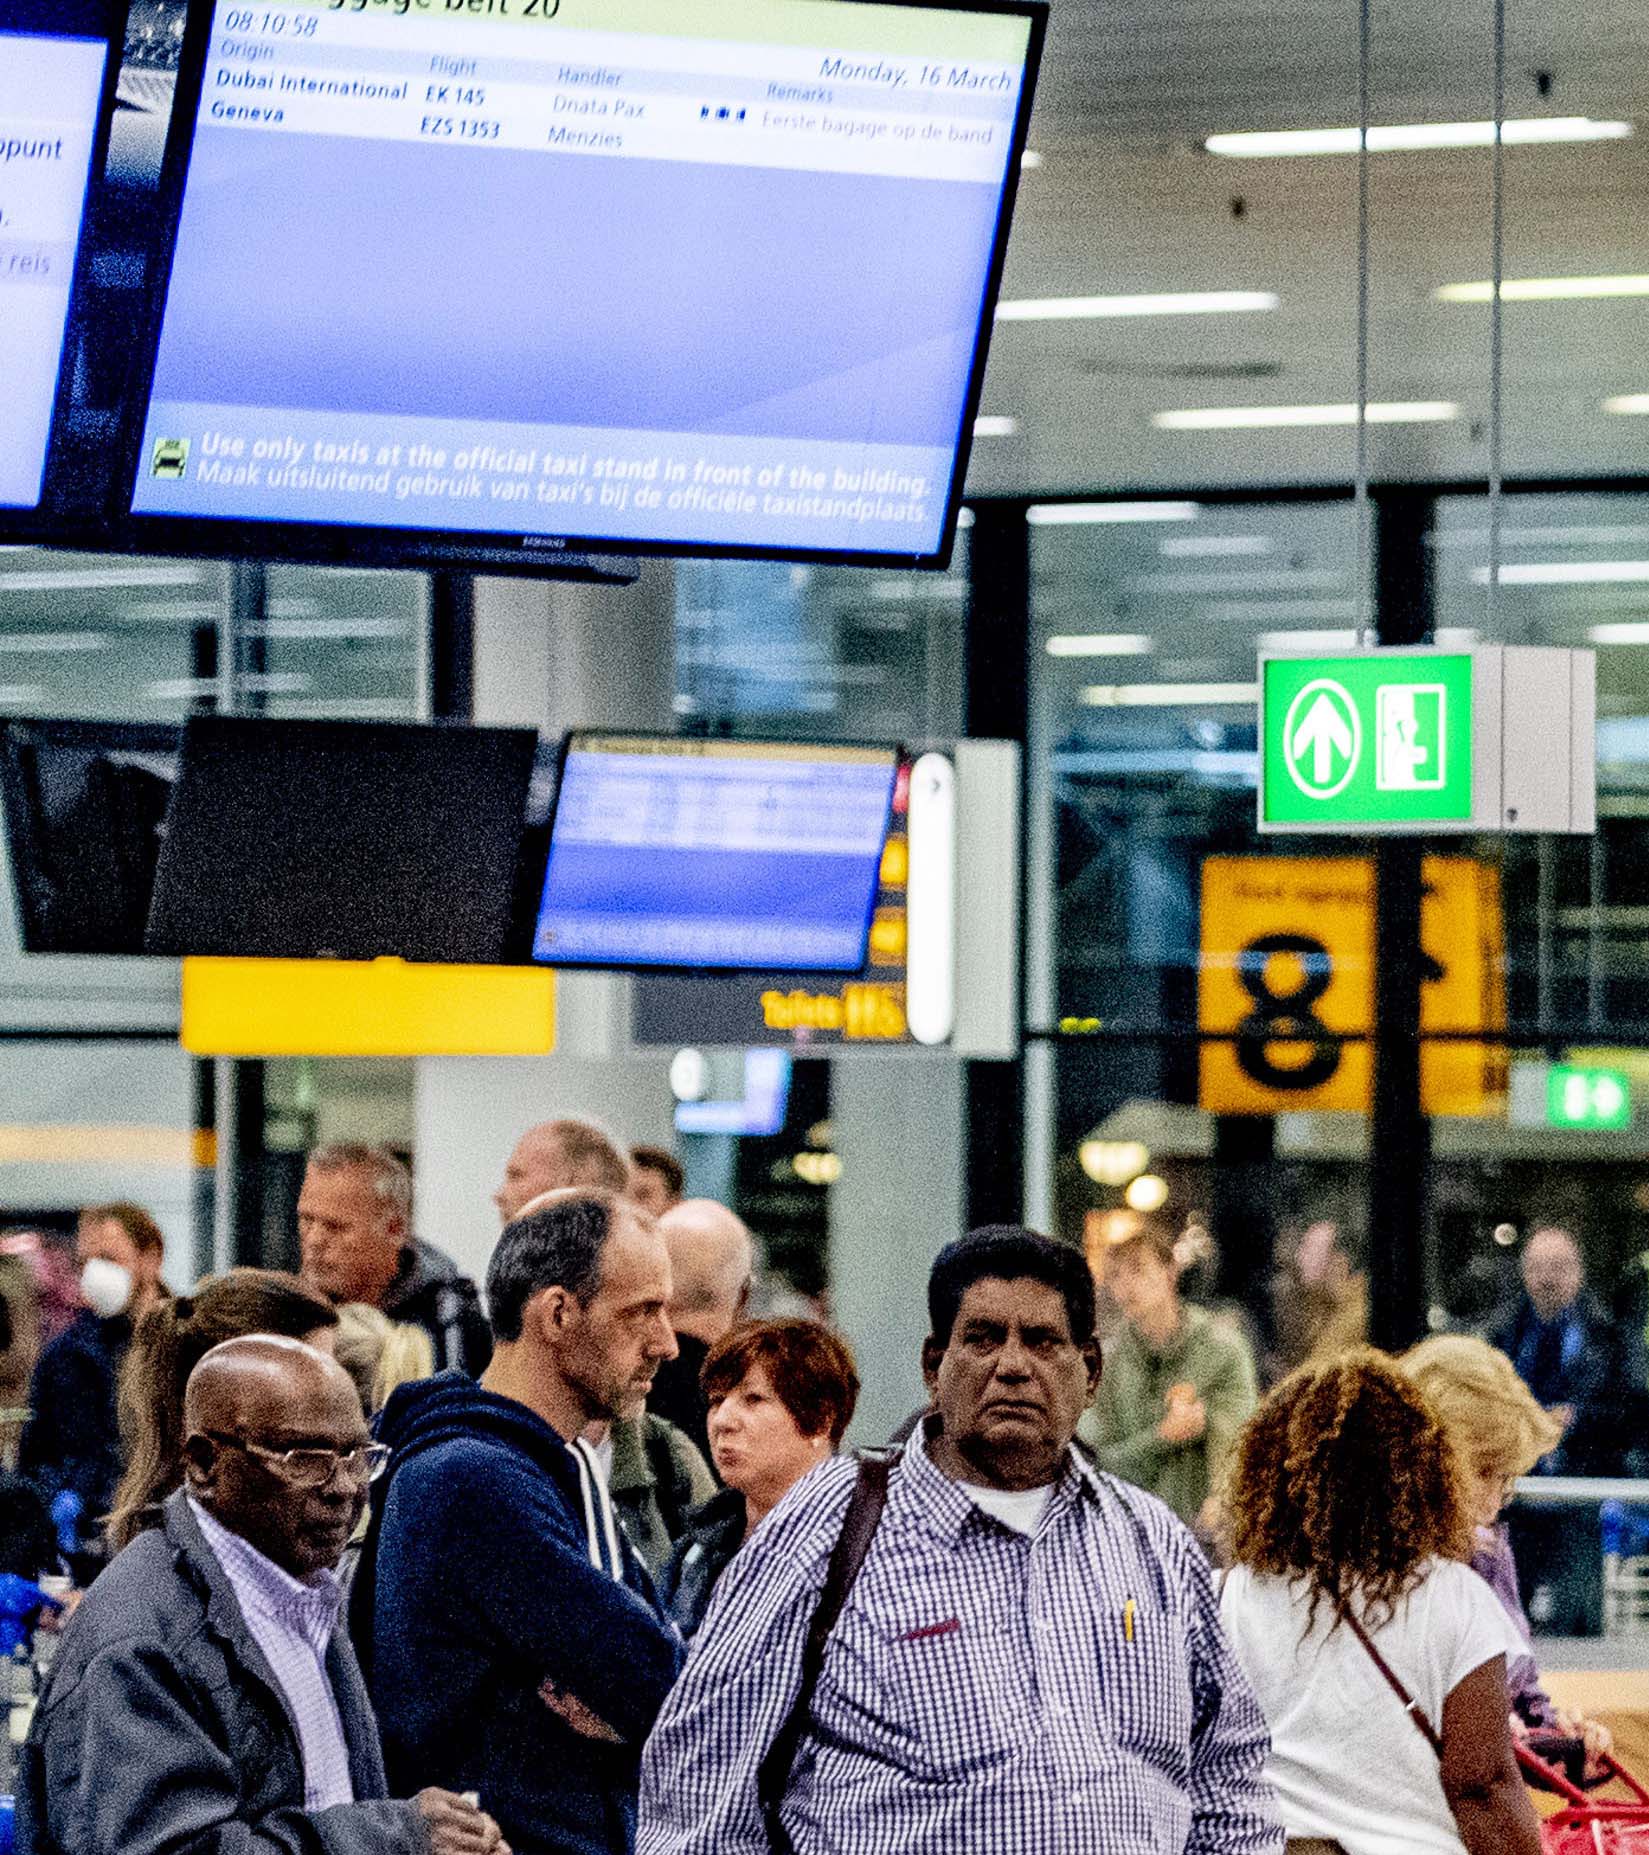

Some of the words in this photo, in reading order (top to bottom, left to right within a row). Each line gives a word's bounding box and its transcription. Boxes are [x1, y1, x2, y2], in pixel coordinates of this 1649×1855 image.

[225, 10, 318, 38] 08:10:58
[220, 38, 274, 61] Origin
[429, 55, 478, 76] Flight
[557, 66, 623, 88] Handler
[766, 82, 833, 104] Remarks
[818, 57, 909, 87] Monday,
[920, 65, 941, 87] 16
[947, 67, 1012, 92] March
[210, 102, 285, 123] Geneva
[547, 126, 624, 148] Menzies
[216, 69, 274, 91] Dubai
[280, 73, 408, 101] International
[425, 86, 451, 104] EK
[456, 89, 485, 106] 145
[554, 96, 609, 117] Dnata
[613, 98, 647, 120] Pax
[762, 111, 816, 132] Eerste
[821, 112, 888, 139] bagage
[893, 123, 917, 143] op
[921, 120, 943, 141] de
[948, 123, 993, 145] band
[197, 460, 259, 486] Maak
[267, 463, 390, 493] uitsluitend
[395, 468, 483, 500] gebruik
[490, 478, 530, 500] van
[536, 480, 594, 505] taxi's
[600, 483, 629, 511] bij
[633, 486, 663, 509] de
[201, 432, 246, 458] Use
[252, 436, 304, 467] only
[313, 440, 369, 466] taxis
[375, 443, 402, 467] at
[408, 443, 447, 469] the
[453, 446, 535, 475] official
[542, 452, 587, 476] taxi
[592, 456, 660, 481] stand
[664, 458, 687, 482] in
[694, 460, 752, 486] front
[757, 461, 784, 486] of
[789, 465, 826, 491] the
